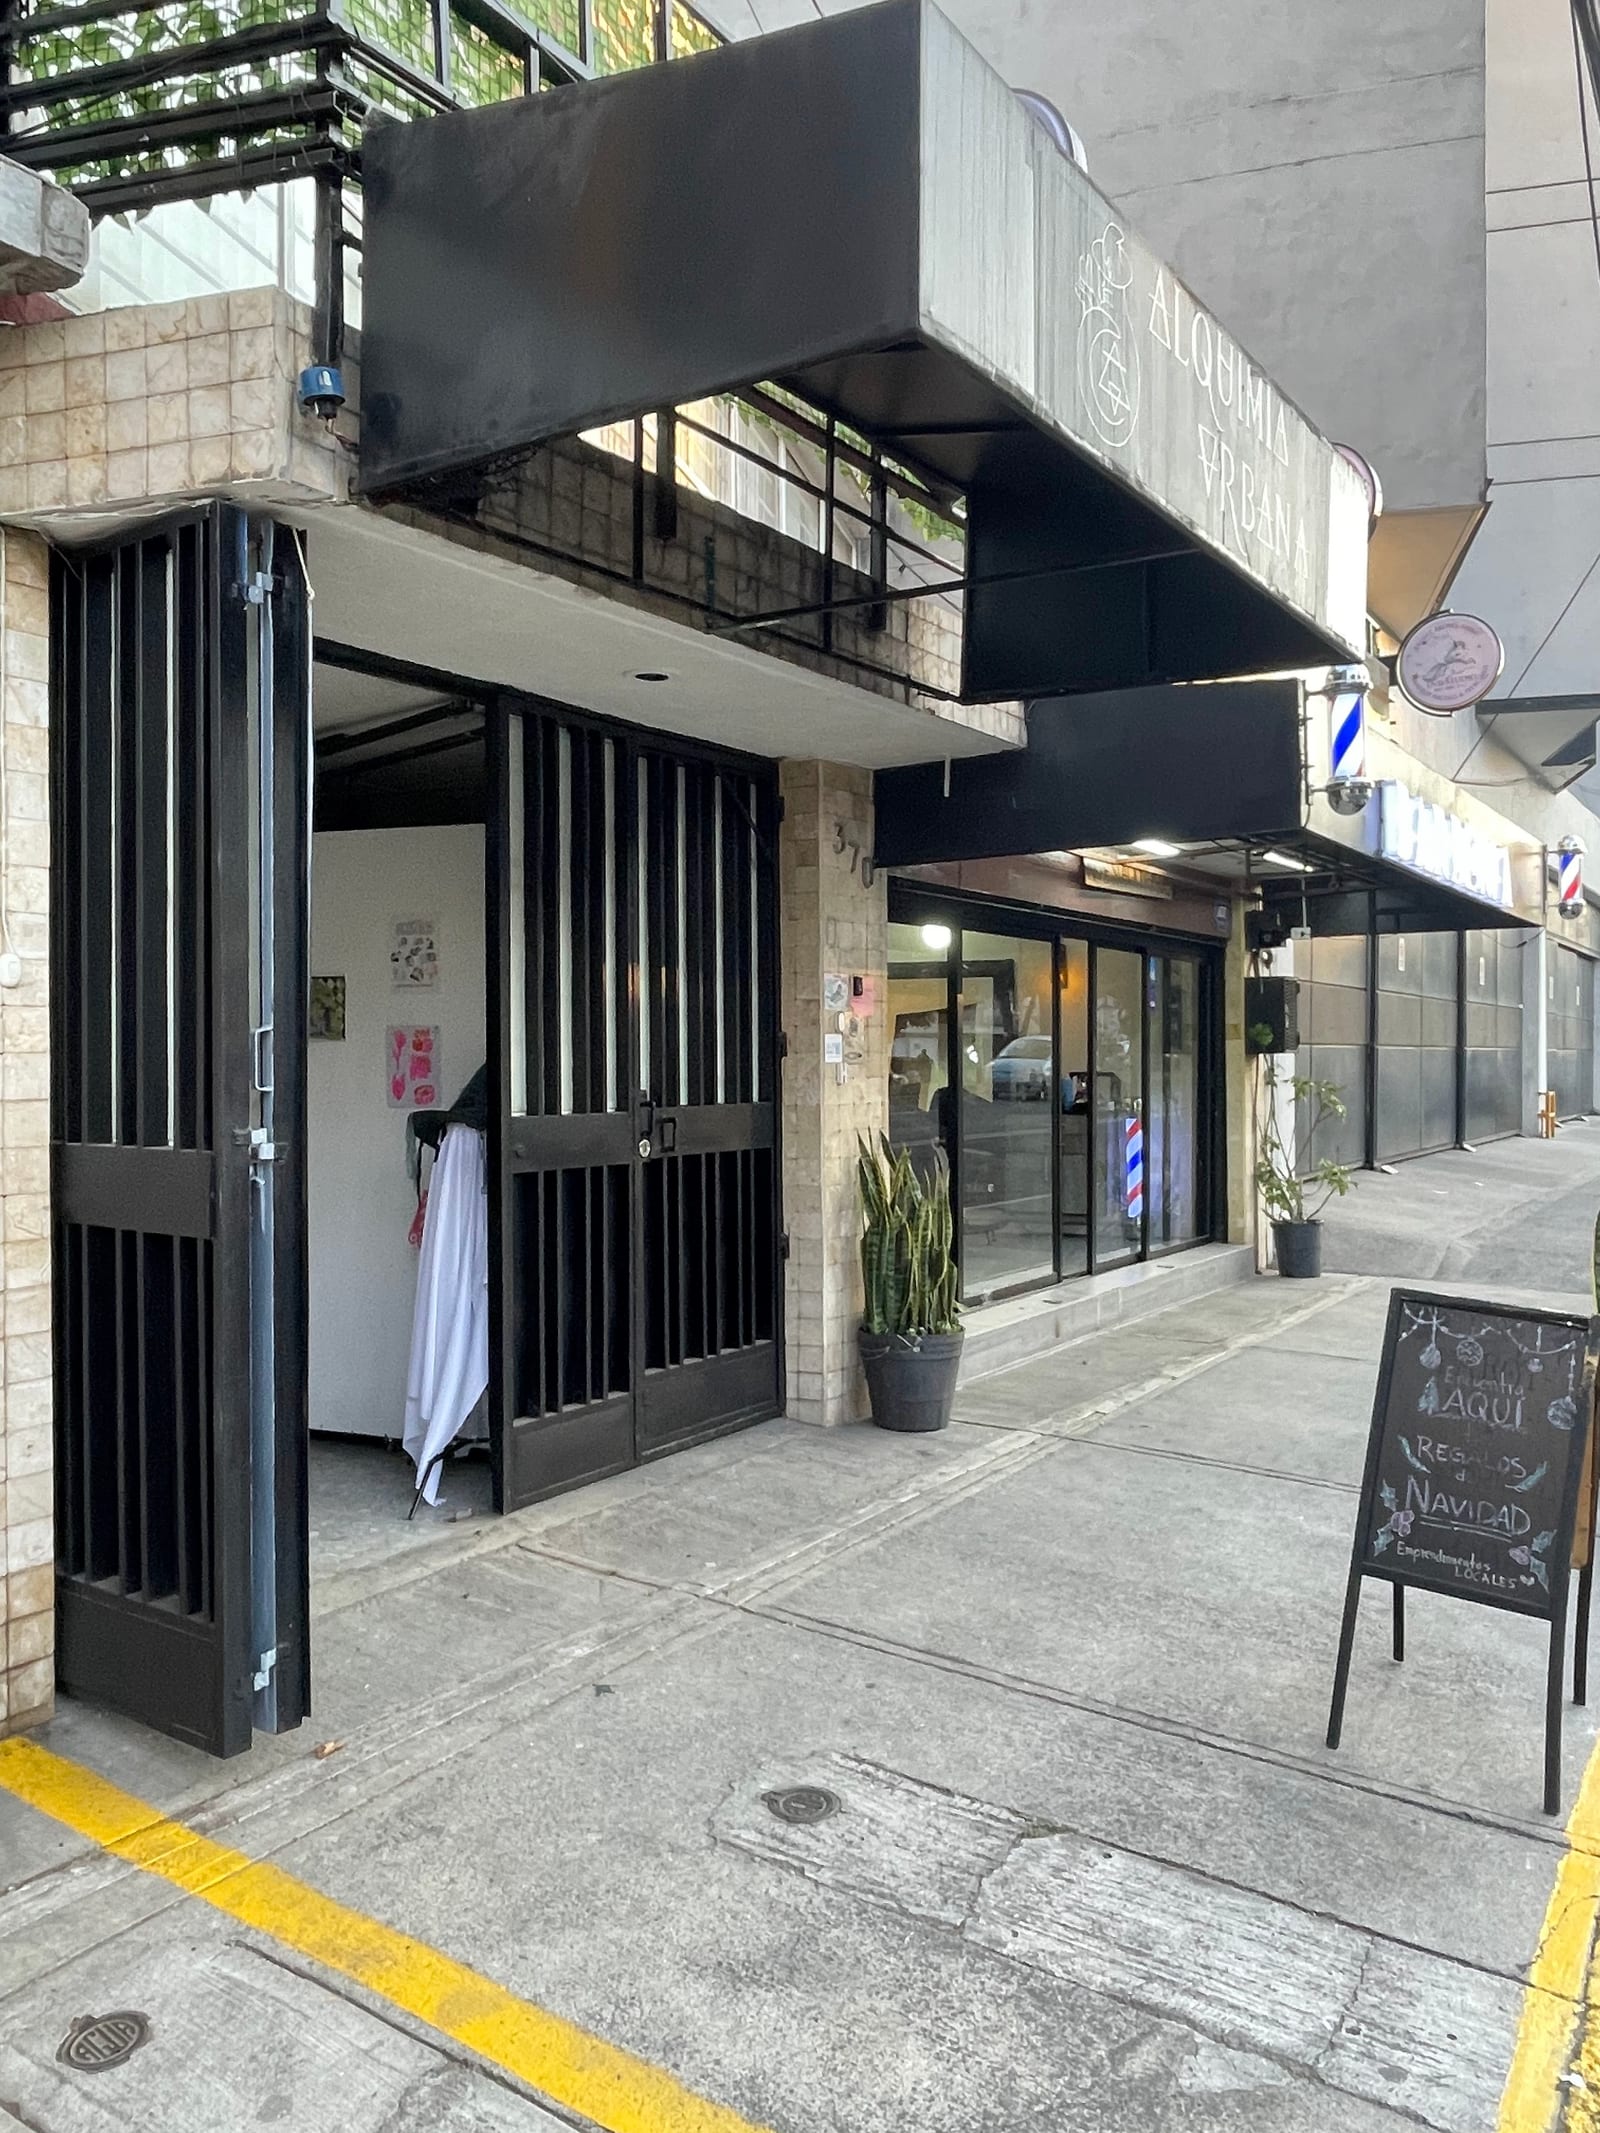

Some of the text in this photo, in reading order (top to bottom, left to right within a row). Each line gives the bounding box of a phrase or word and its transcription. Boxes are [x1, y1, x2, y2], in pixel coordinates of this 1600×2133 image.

[1149, 267, 1289, 467] ALQUIMIA
[832, 821, 874, 889] 370
[1404, 1475, 1531, 1535] NAVIDAD
[1455, 1566, 1517, 1589] LOCALES
